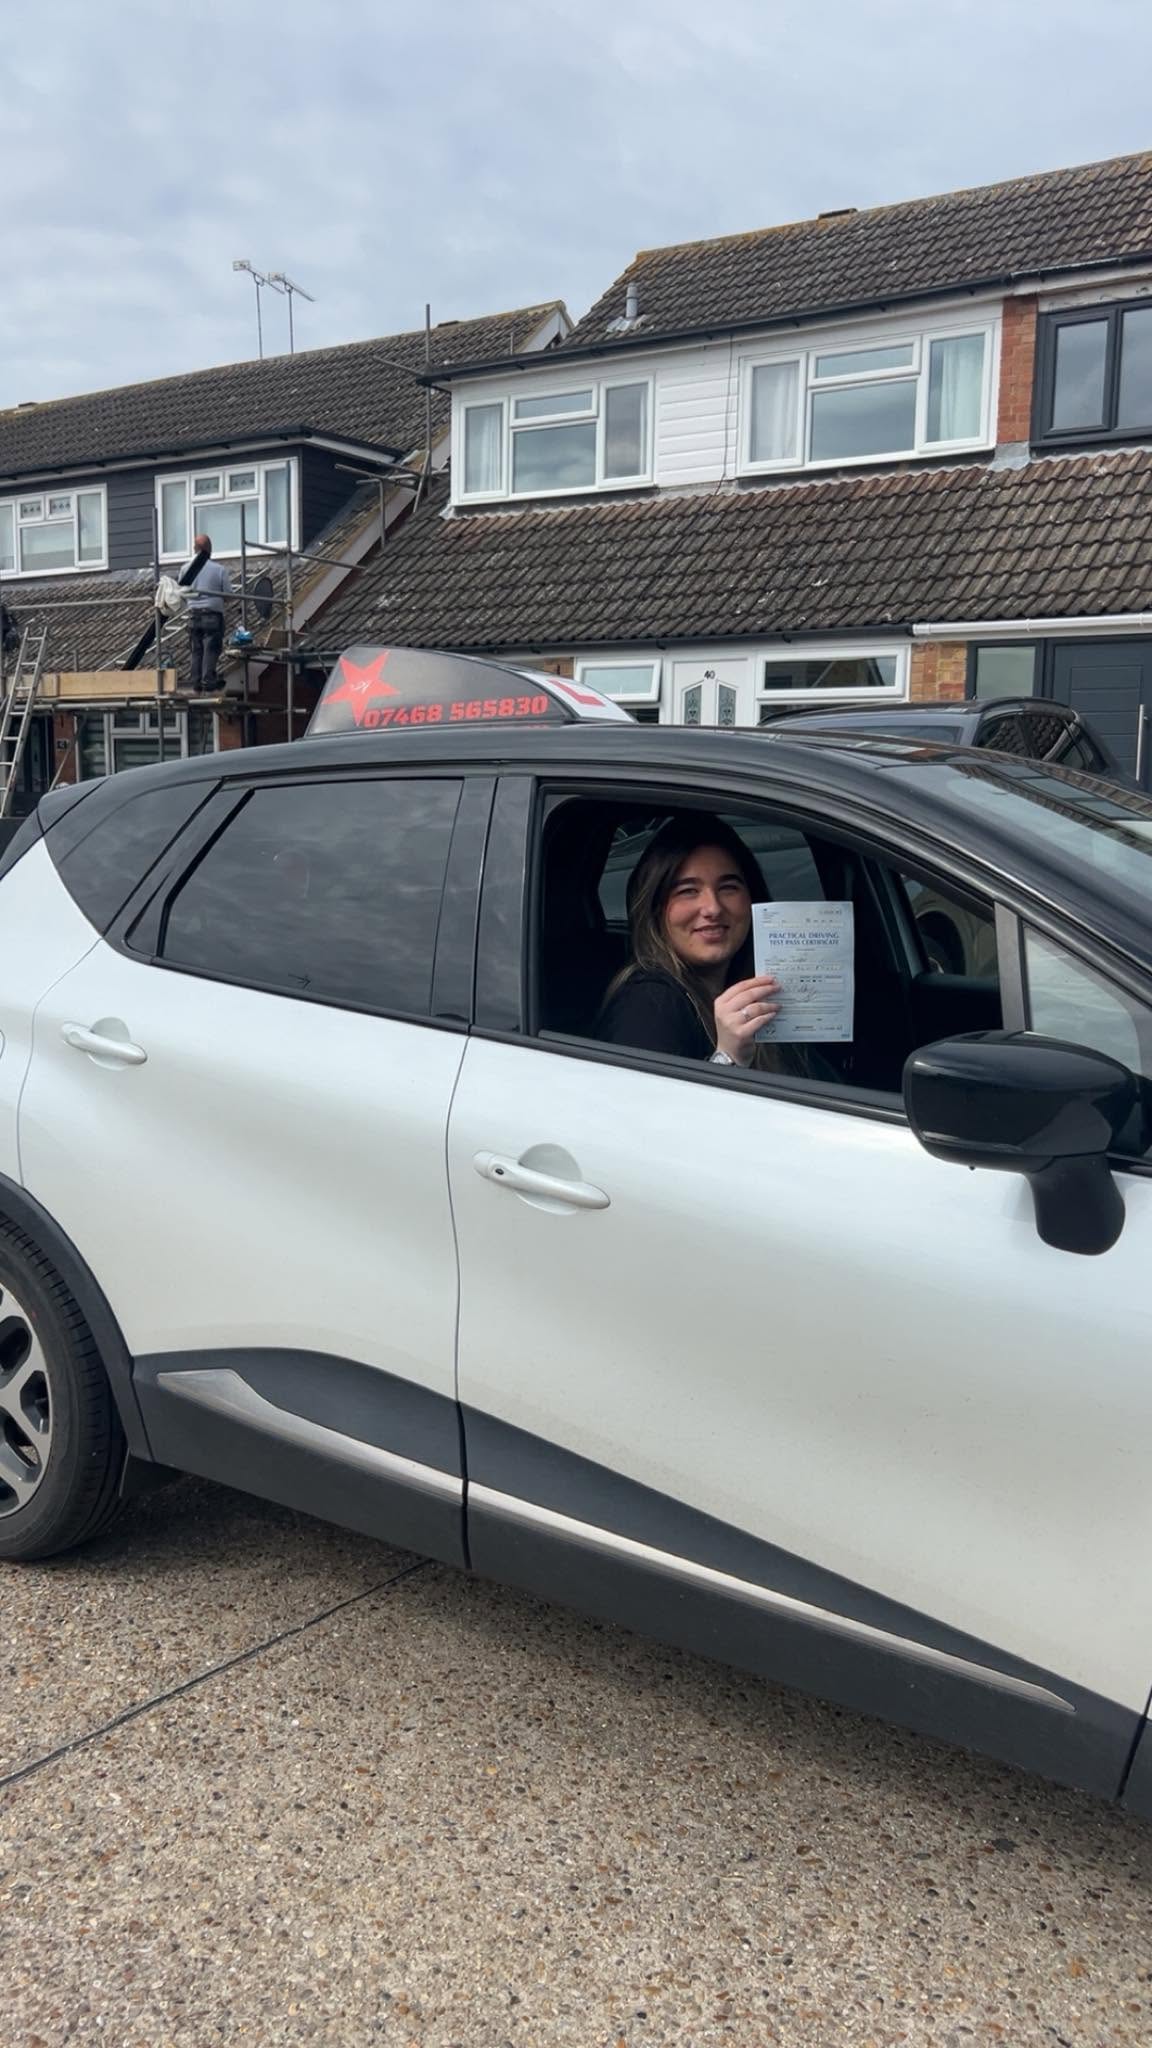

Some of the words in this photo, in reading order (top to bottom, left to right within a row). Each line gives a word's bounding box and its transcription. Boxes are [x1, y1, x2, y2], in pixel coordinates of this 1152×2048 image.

[704, 670, 715, 680] 40
[364, 707, 442, 728] 07468
[449, 696, 549, 721] 565830
[808, 931, 839, 939] DRIVING
